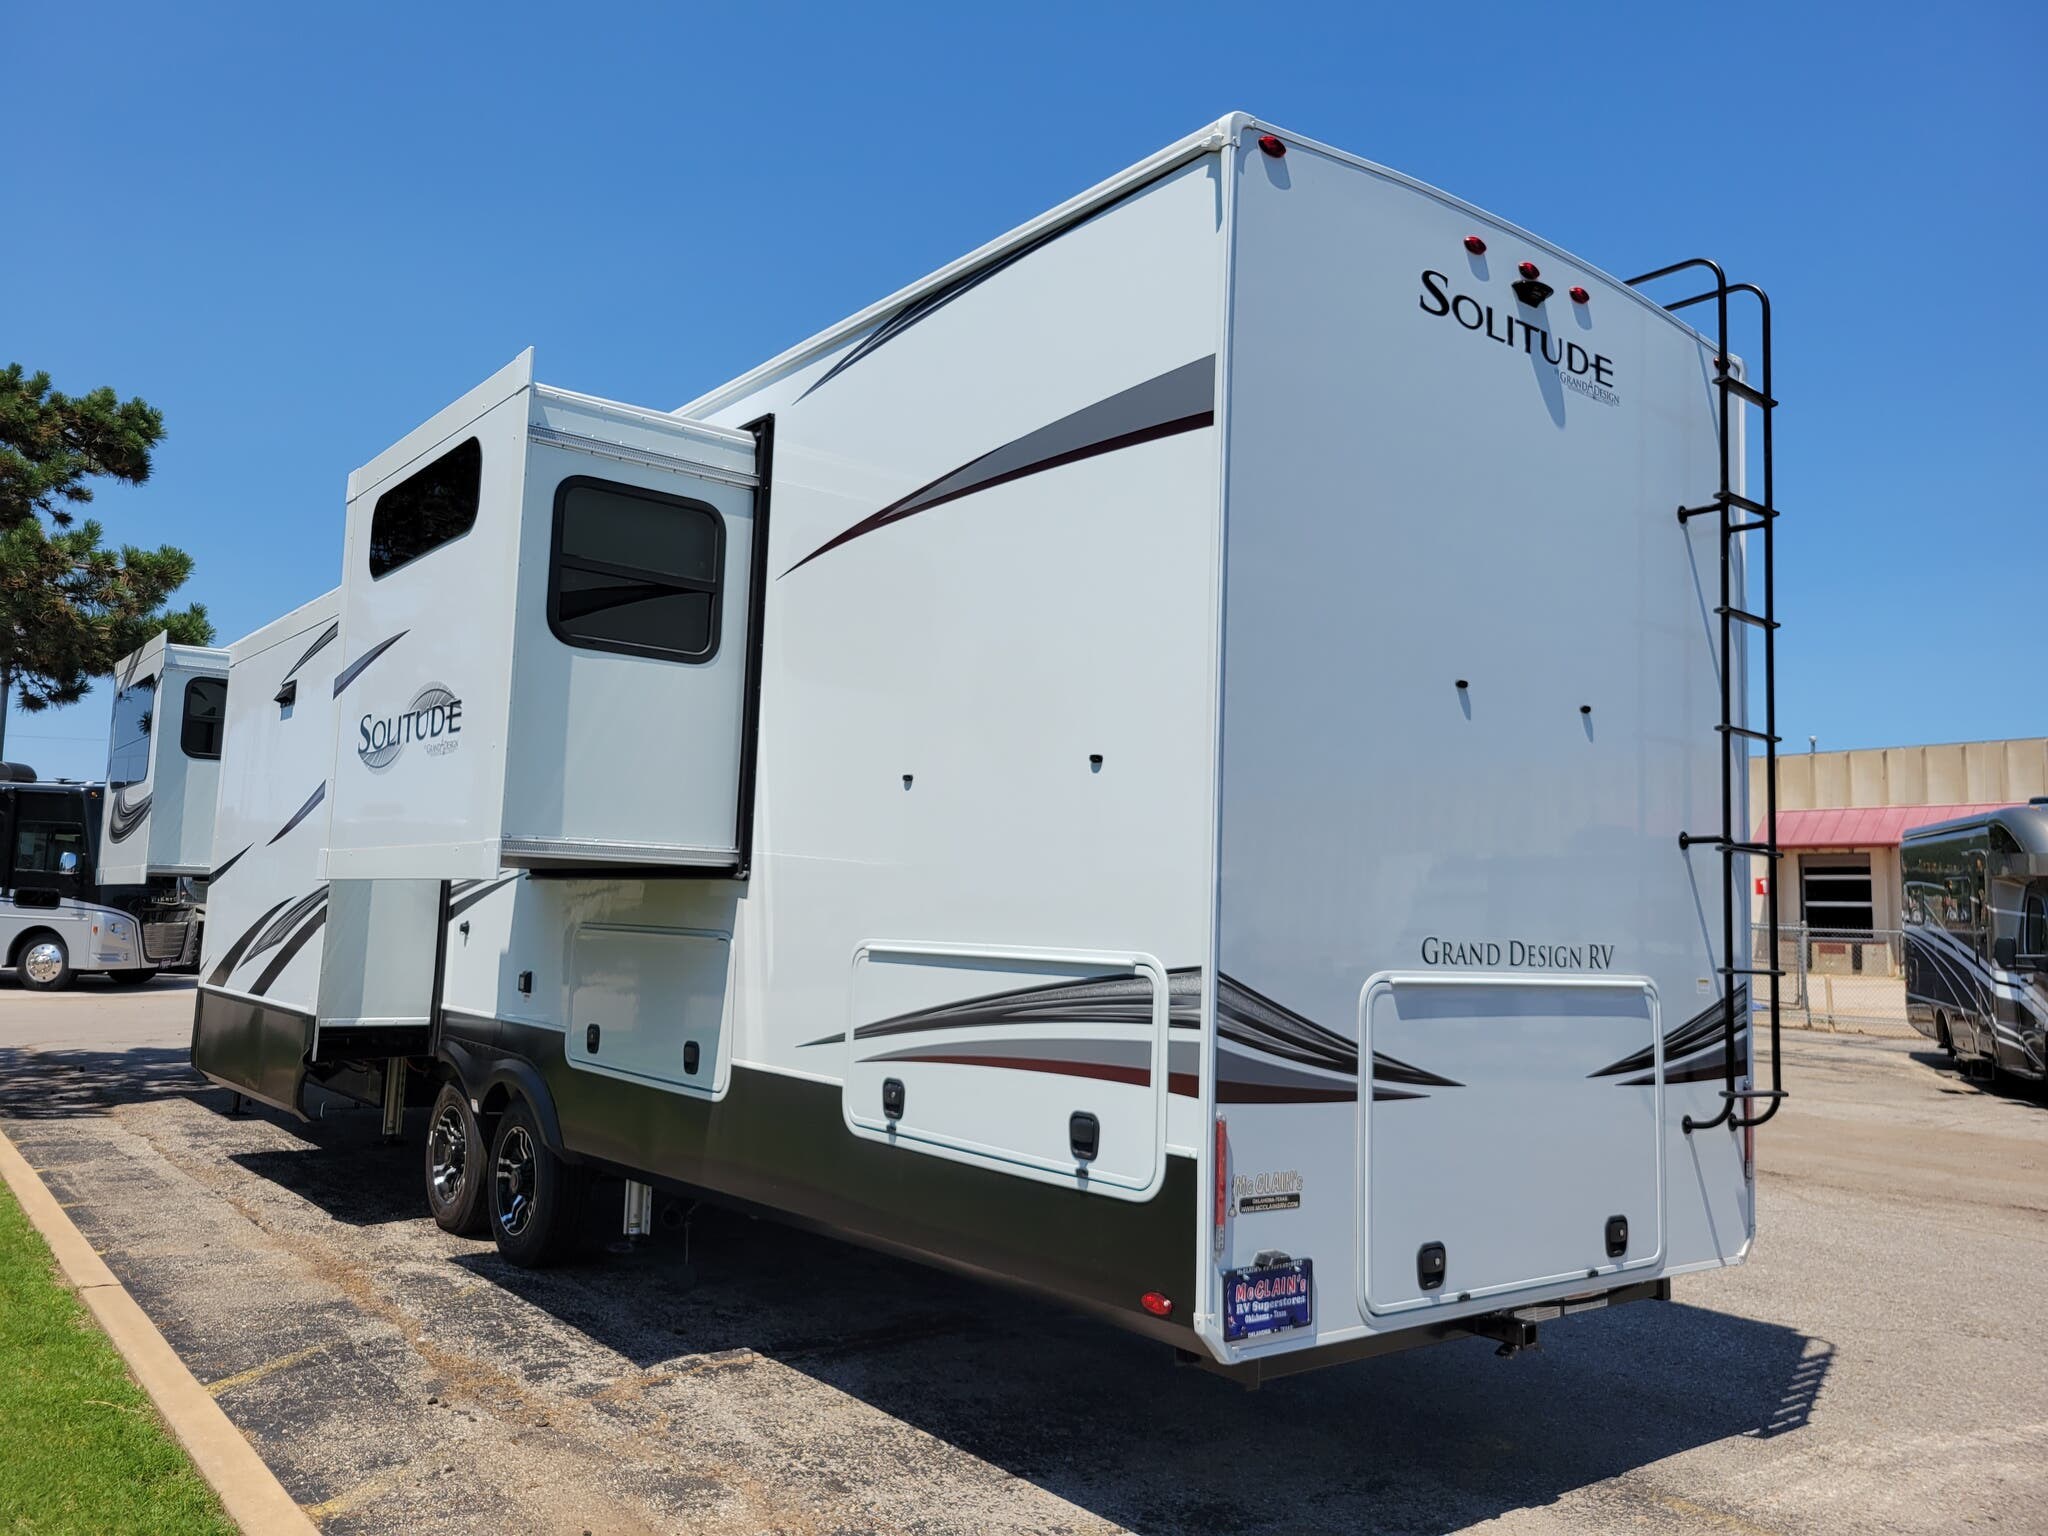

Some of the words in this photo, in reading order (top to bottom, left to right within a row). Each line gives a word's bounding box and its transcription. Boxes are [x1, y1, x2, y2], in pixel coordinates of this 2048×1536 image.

[1419, 270, 1614, 388] SOLITUDE
[358, 699, 462, 754] SOLITUDE
[1421, 936, 1501, 966] GRAND
[1509, 940, 1582, 968] DESIGN
[1588, 943, 1615, 969] RV
[1236, 1302, 1251, 1315] RV
[1252, 1295, 1306, 1312] Superstores
